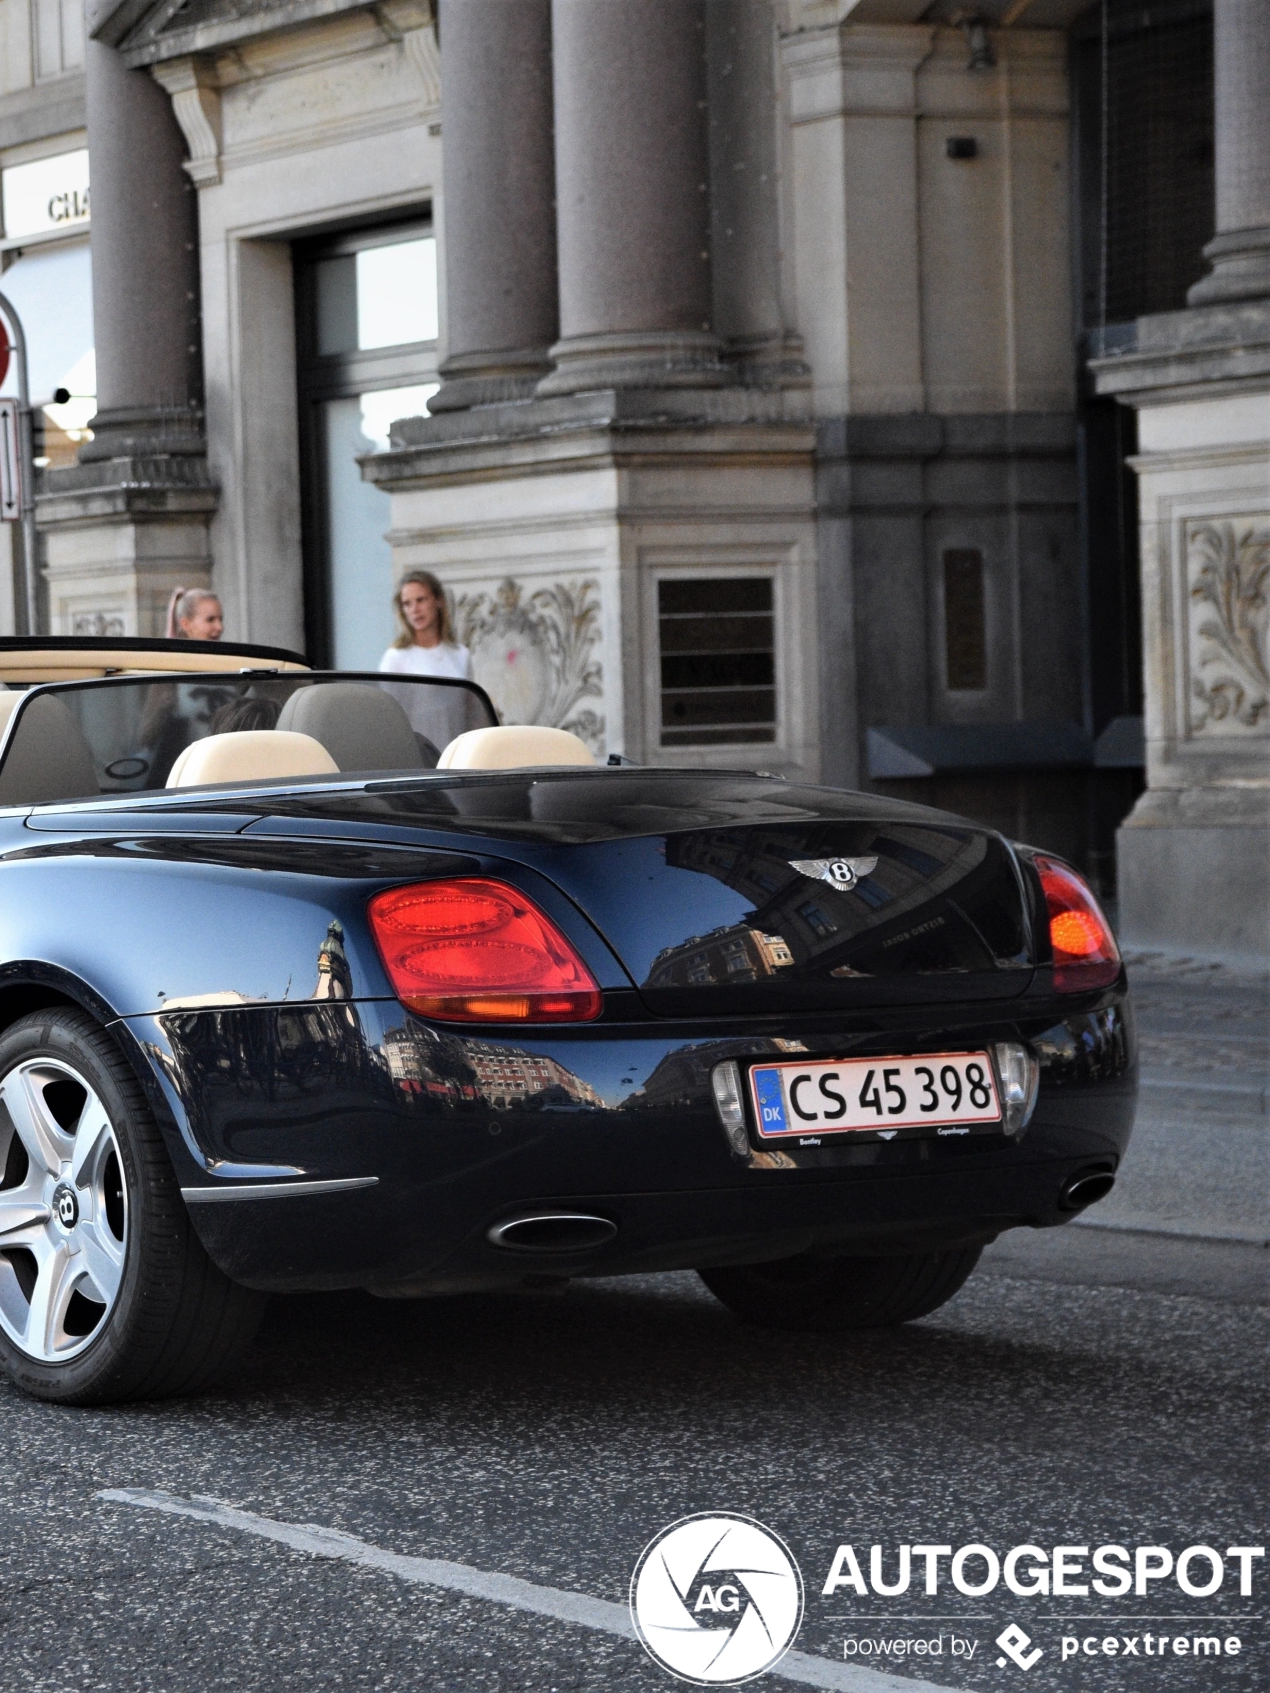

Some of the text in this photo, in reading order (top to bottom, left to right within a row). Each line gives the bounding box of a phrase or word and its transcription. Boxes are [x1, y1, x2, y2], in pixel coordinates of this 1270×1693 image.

[831, 862, 852, 882] B
[789, 1062, 992, 1121] CS 45 398
[763, 1106, 782, 1122] DK
[799, 1127, 970, 1146] Bentley Copenhagen
